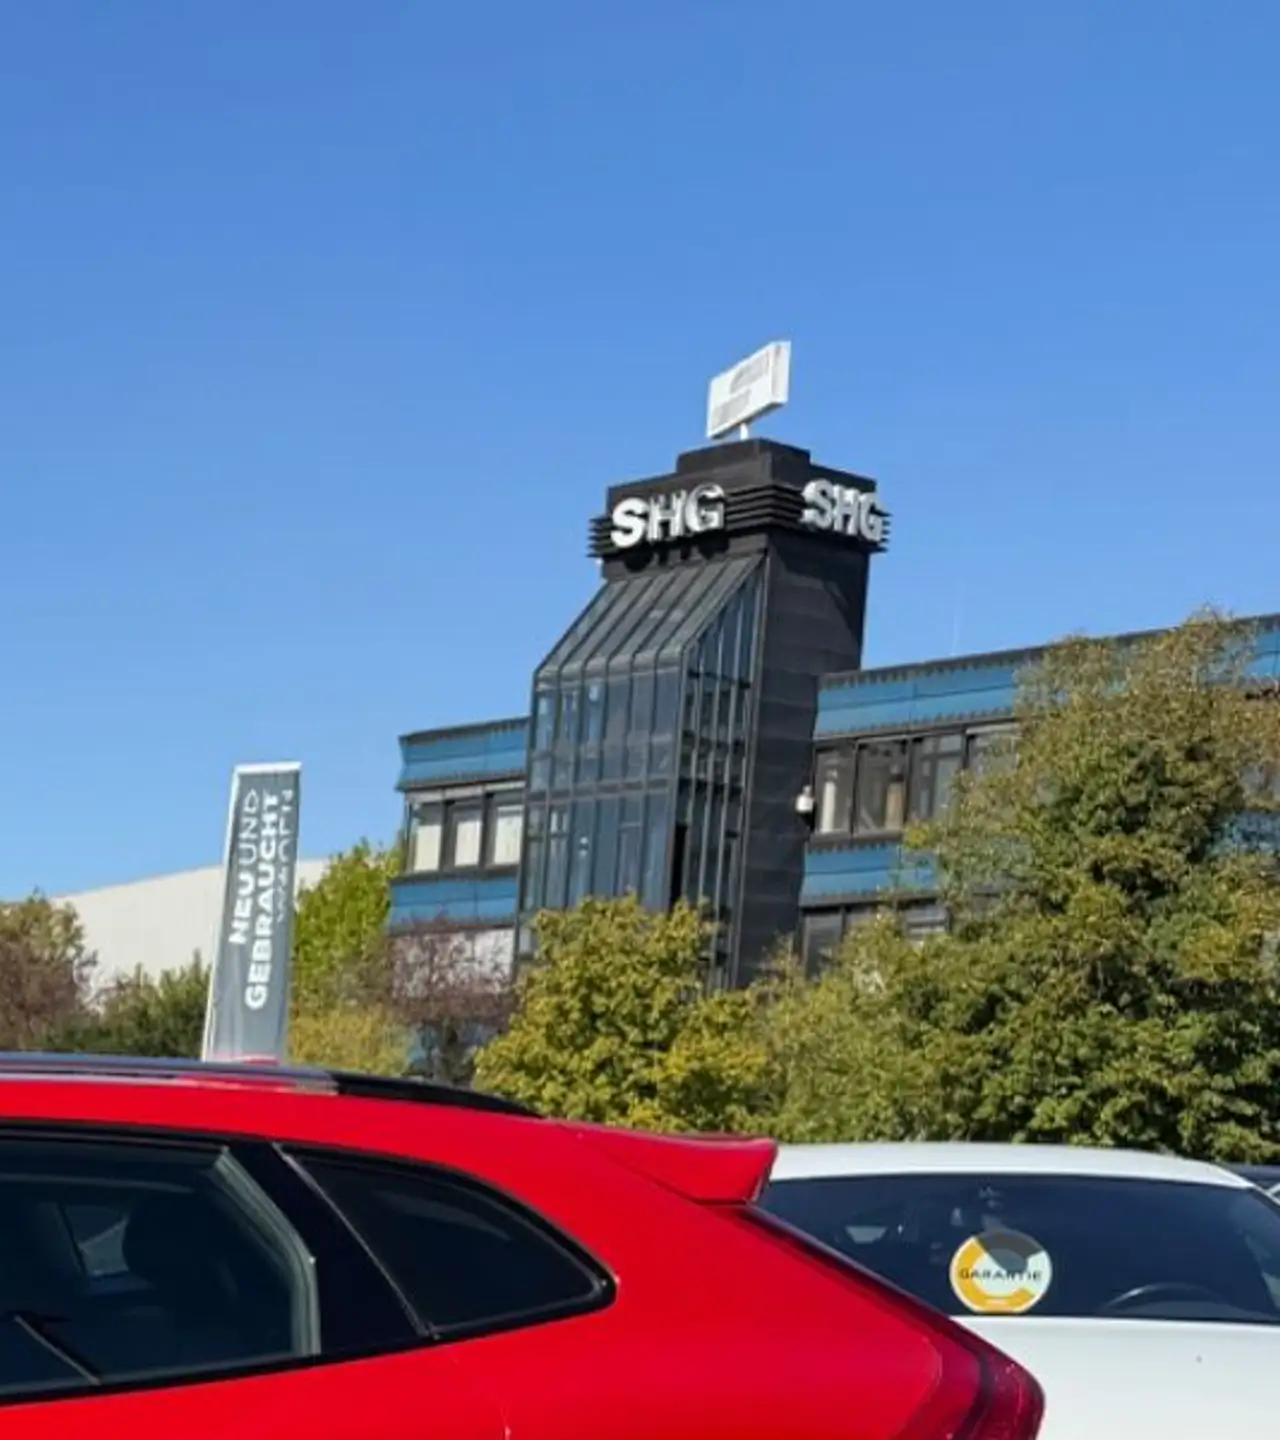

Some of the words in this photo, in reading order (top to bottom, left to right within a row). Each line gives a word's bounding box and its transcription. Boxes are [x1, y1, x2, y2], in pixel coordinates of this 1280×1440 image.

[610, 484, 725, 548] SHG
[801, 479, 883, 543] SHG
[238, 788, 260, 865] UND
[230, 871, 255, 945] NEU
[245, 789, 279, 1010] GEBRAUCHT
